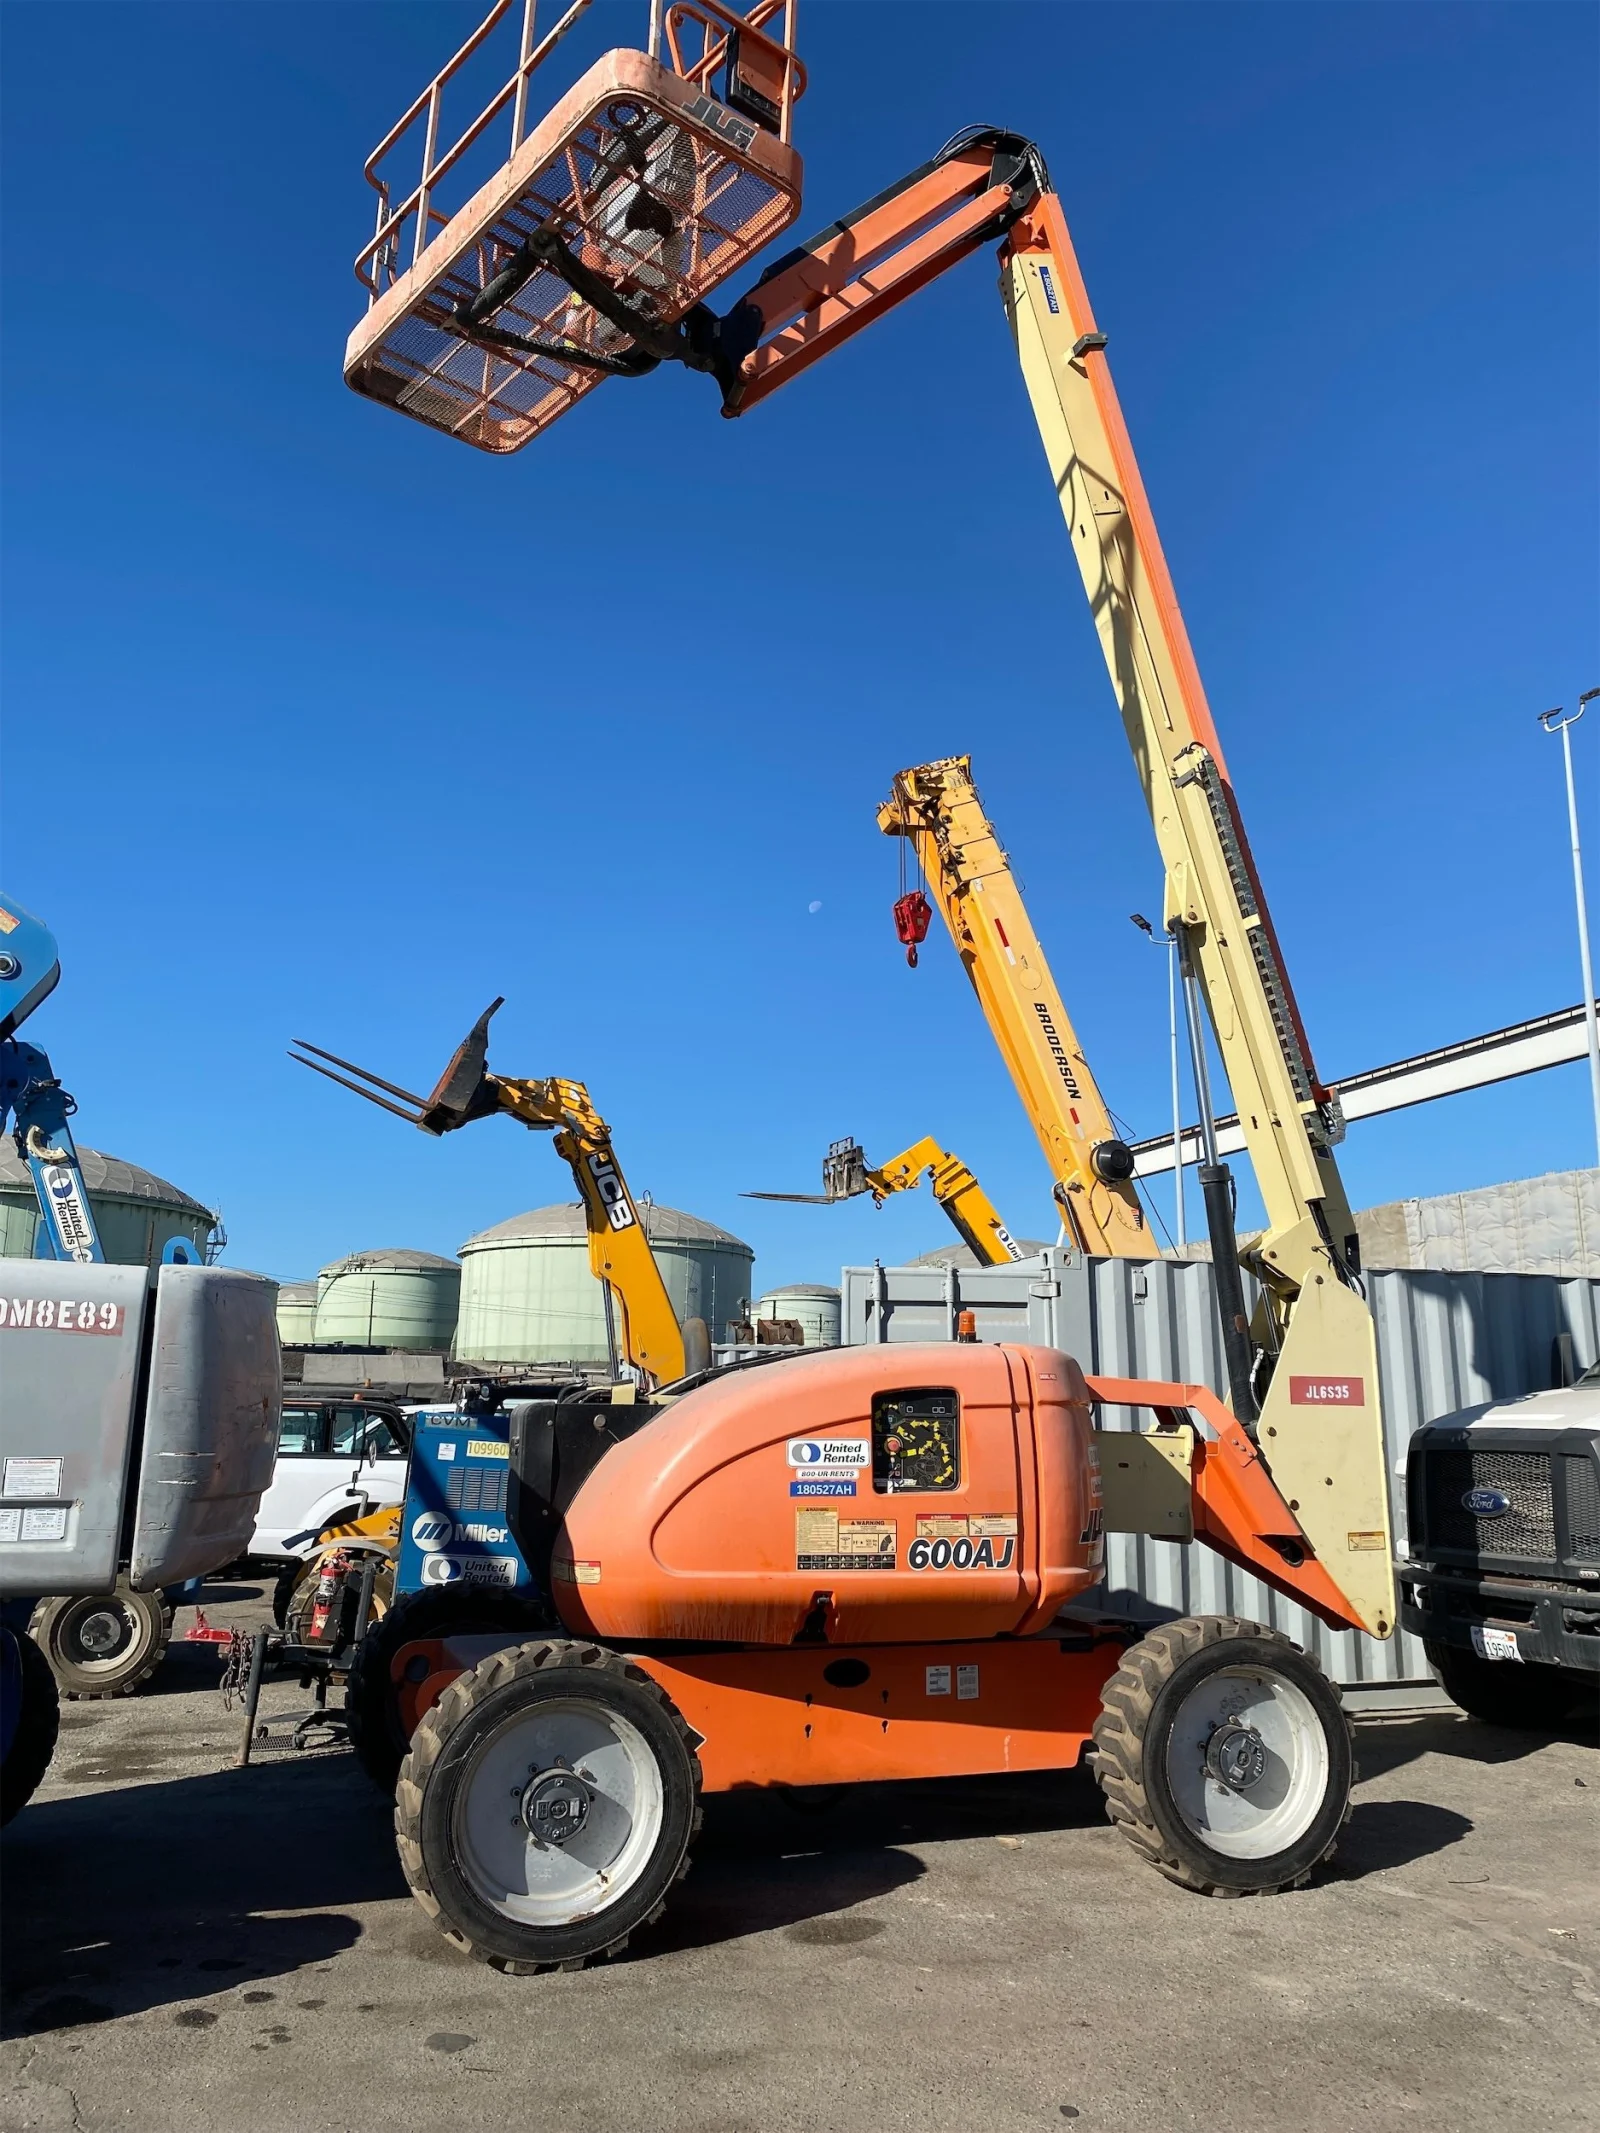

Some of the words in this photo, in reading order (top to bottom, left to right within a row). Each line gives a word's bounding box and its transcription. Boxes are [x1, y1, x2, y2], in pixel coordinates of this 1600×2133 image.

[681, 94, 758, 154] JLG
[1033, 1003, 1082, 1099] BRODERSON
[589, 1154, 633, 1230] JCB
[56, 1202, 76, 1245] Rentals
[66, 1199, 88, 1239] United
[1006, 1242, 1022, 1259] Uni
[468, 1442, 509, 1457] 109960
[823, 1443, 862, 1453] United
[823, 1453, 866, 1463] Rentals
[796, 1484, 852, 1495] 180527AH
[1469, 1493, 1495, 1509] Ford
[907, 1537, 1015, 1570] 600AJ
[465, 1561, 508, 1572] United
[463, 1571, 510, 1584] Rentals
